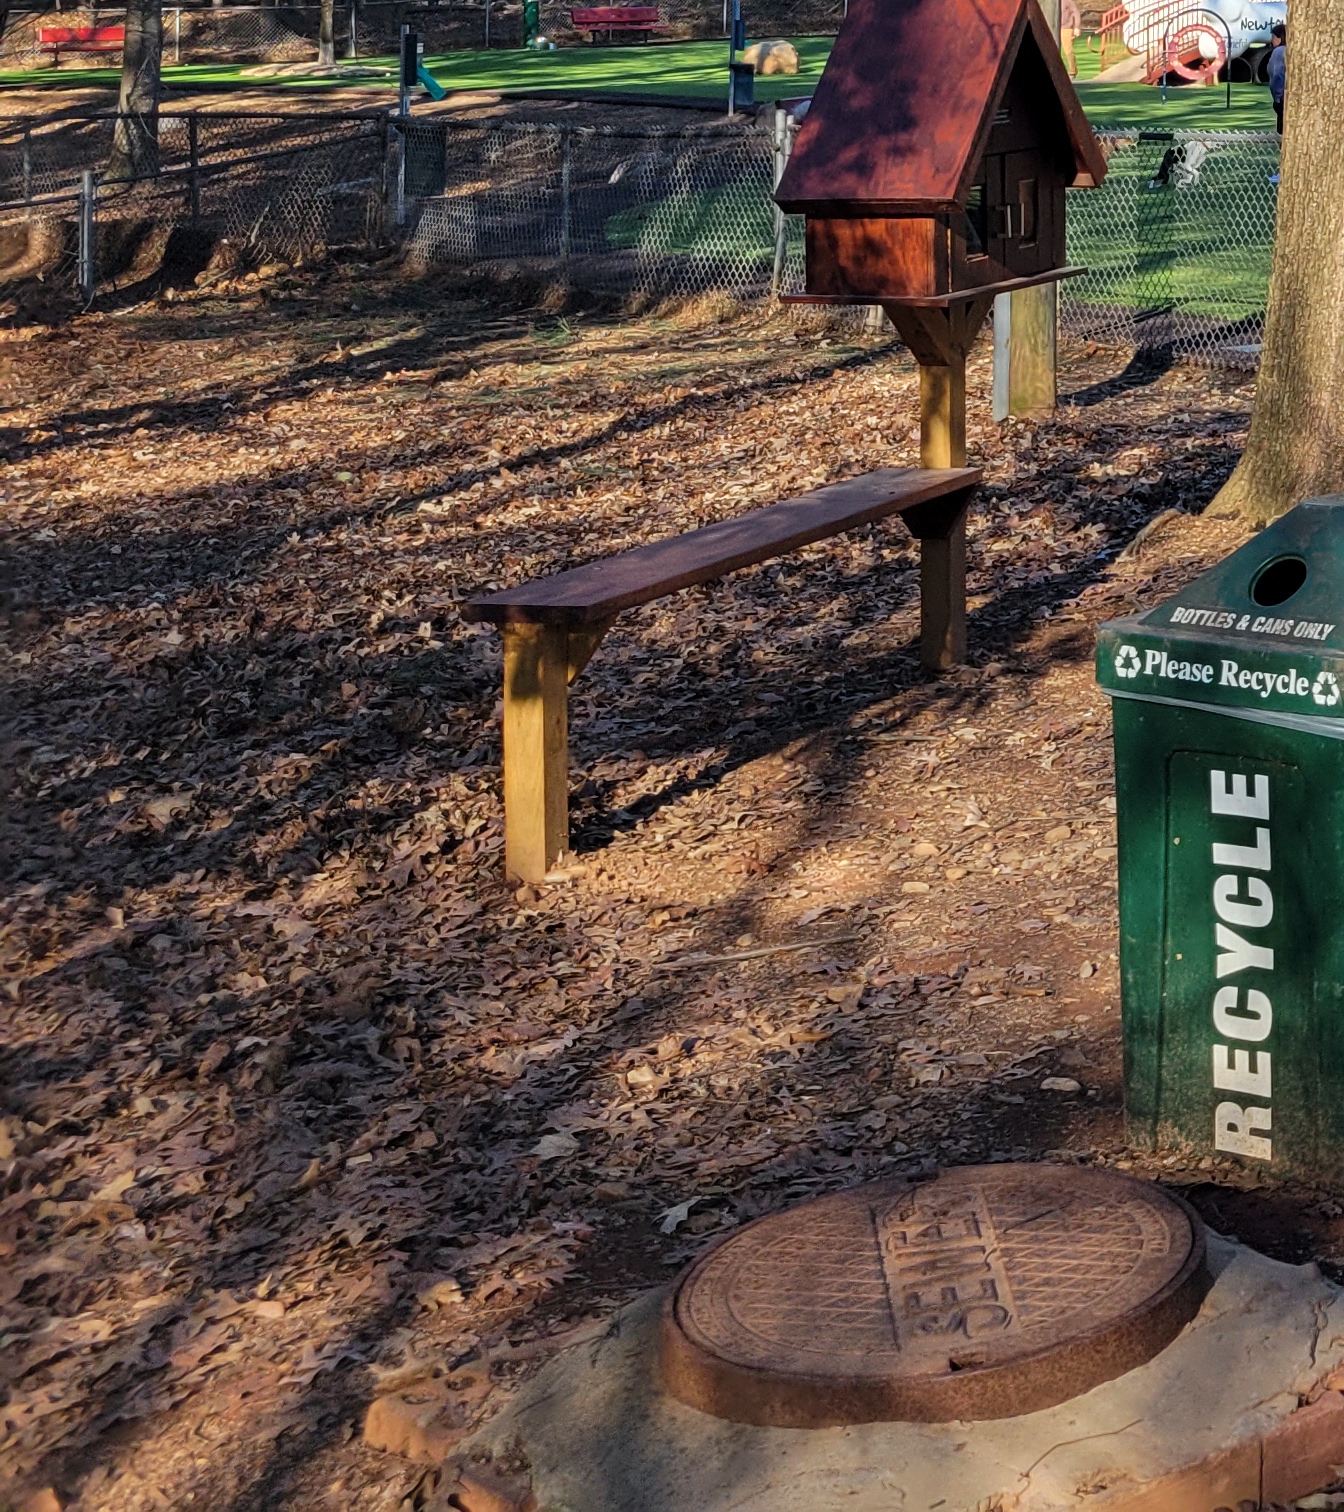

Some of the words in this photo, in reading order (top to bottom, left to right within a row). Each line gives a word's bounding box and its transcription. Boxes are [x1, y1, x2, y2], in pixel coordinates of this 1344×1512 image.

[1170, 607, 1236, 628] BOTTLES
[1236, 614, 1250, 630] &
[1252, 617, 1294, 635] CANS
[1293, 621, 1336, 640] ONLY
[1144, 648, 1214, 684] Please
[1219, 660, 1309, 698] Recycle
[1211, 768, 1274, 1160] RECYCLE
